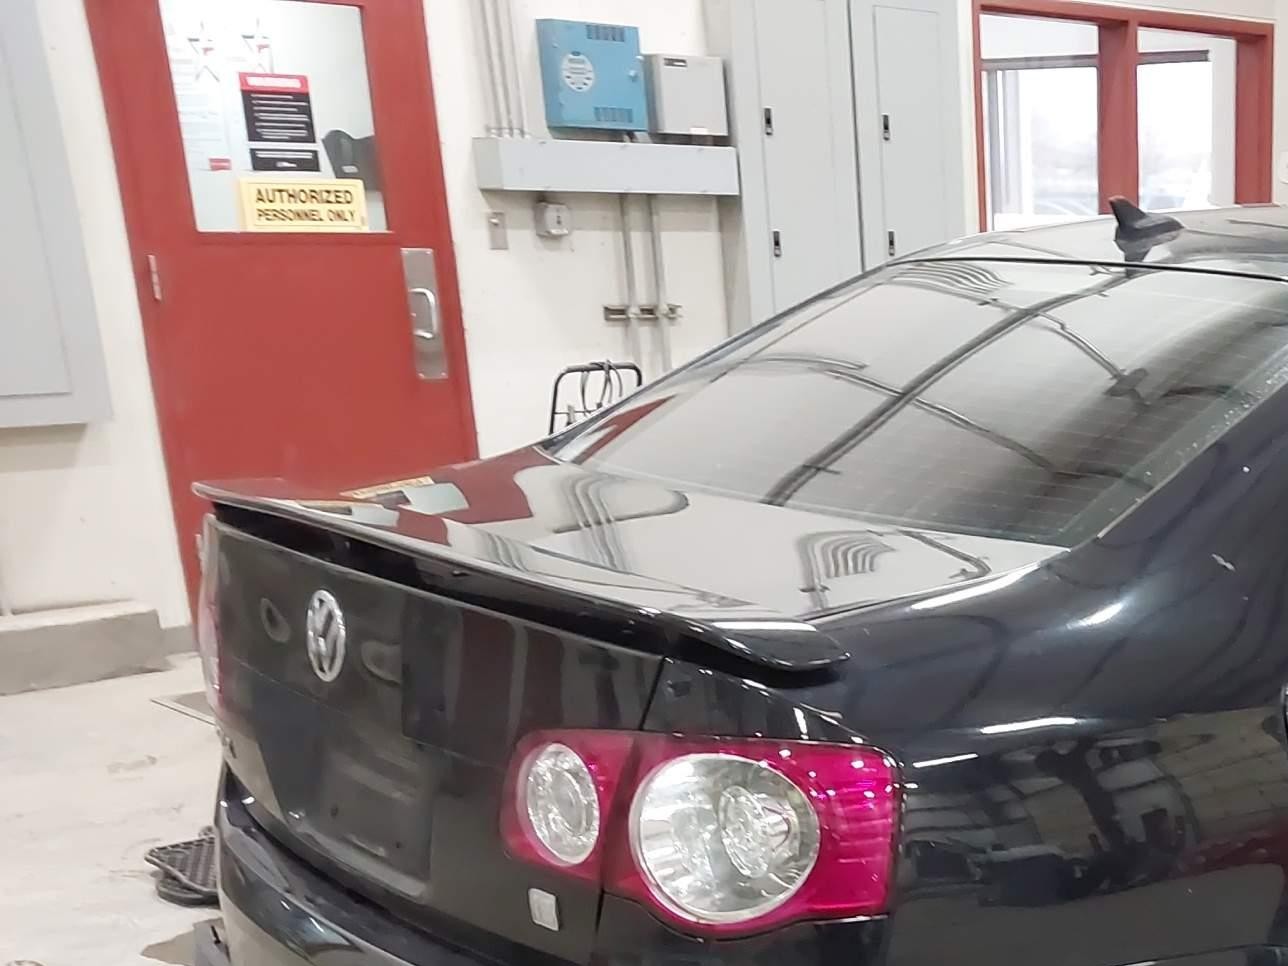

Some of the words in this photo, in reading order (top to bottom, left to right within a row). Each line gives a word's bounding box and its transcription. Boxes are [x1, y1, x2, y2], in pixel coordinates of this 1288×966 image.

[255, 188, 353, 204] AUTHORIZED
[256, 208, 324, 222] PERSONNEL
[327, 209, 355, 222] ONLY
